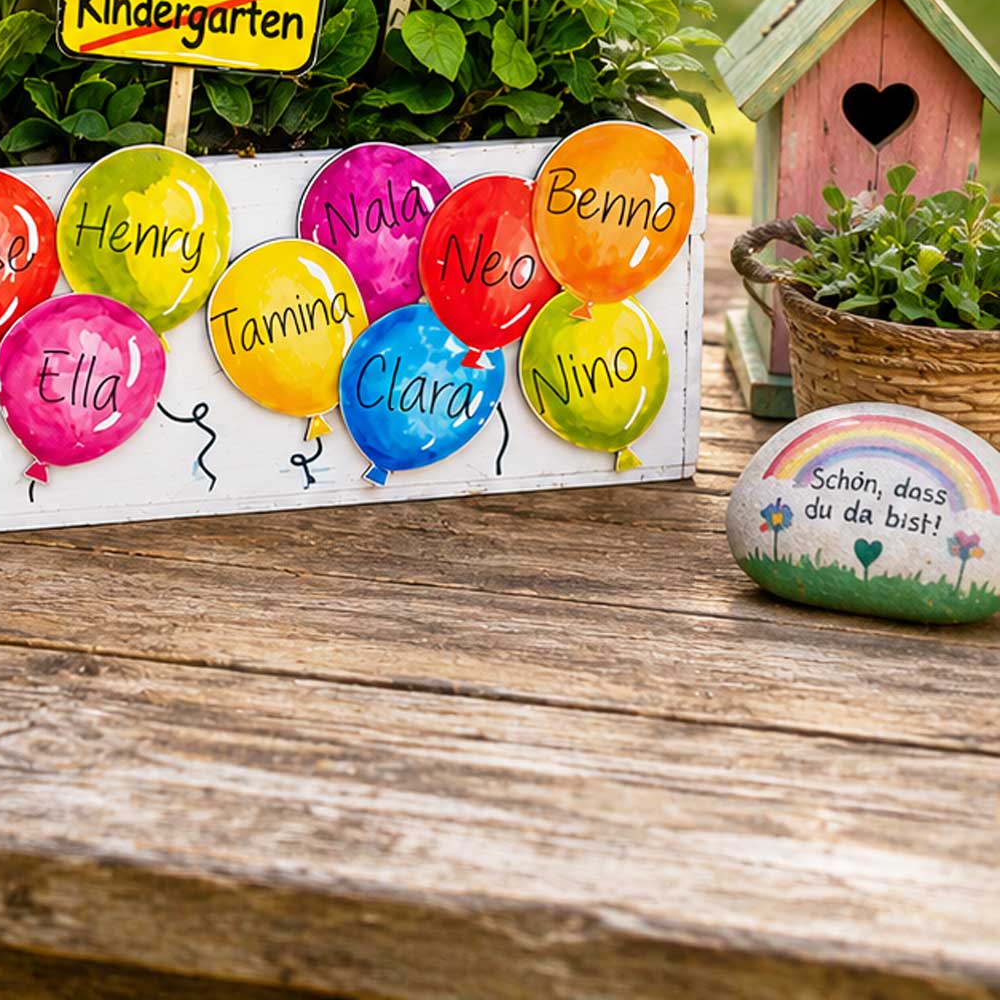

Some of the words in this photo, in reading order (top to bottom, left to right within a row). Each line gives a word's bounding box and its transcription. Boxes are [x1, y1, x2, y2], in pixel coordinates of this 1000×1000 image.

[324, 180, 428, 245] Nala
[547, 167, 677, 234] Benno
[75, 202, 206, 274] Henry
[439, 233, 537, 291] Neo
[209, 291, 356, 356] Tamina
[38, 349, 122, 413] Ella
[355, 353, 476, 422] Clara
[531, 345, 639, 415] Nino
[804, 497, 833, 521] du
[843, 499, 874, 525] da
[884, 505, 942, 537] bist!
[893, 477, 948, 506] dass
